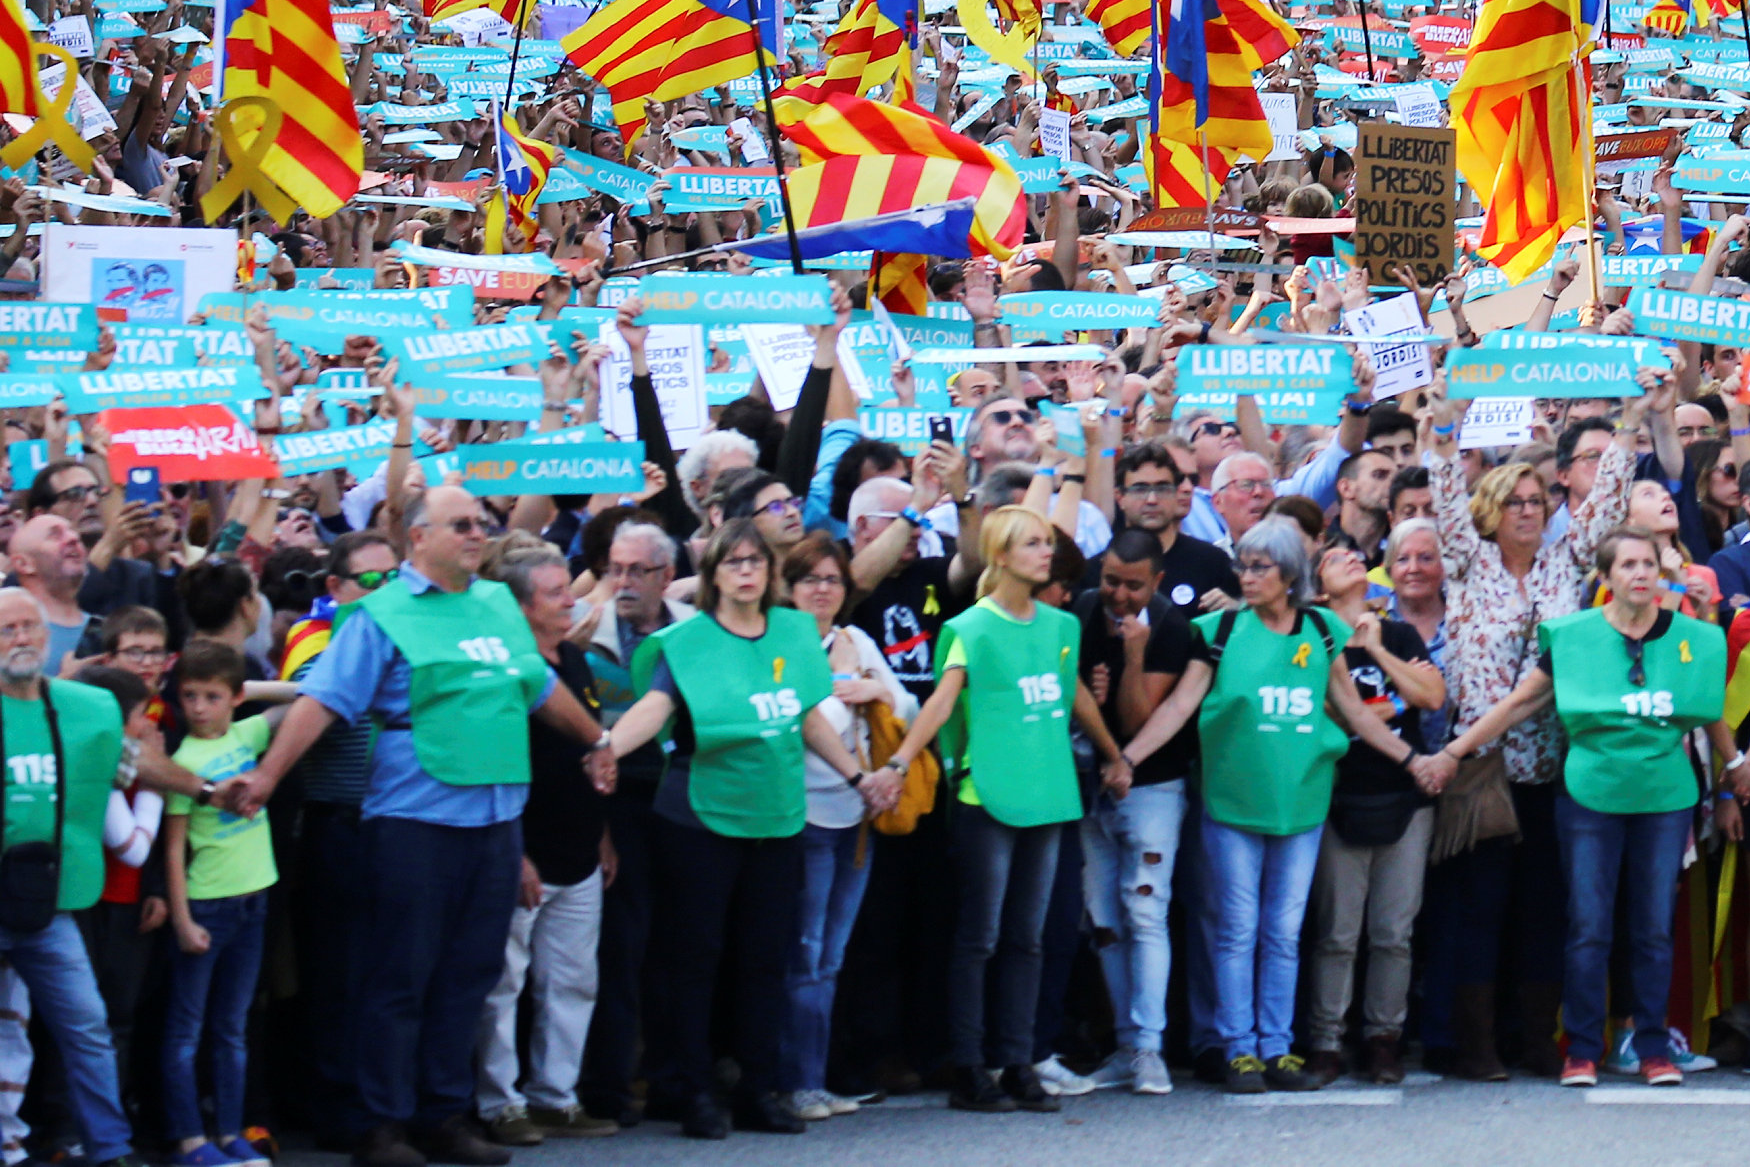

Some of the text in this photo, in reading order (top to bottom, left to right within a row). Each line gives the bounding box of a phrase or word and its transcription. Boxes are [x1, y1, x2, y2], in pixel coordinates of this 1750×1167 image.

[1434, 60, 1466, 73] SAV
[1595, 137, 1668, 155] AVE EUROPE
[598, 169, 646, 192] CATALO
[1371, 165, 1444, 195] PRESOS
[1680, 168, 1723, 181] HELP
[680, 176, 779, 195] LLIBERTA
[438, 268, 499, 288] SAVE
[643, 291, 825, 310] HELP CATALONIA
[998, 302, 1154, 318] HELP CATALONIA
[320, 308, 427, 327] CATALONIA
[1650, 322, 1667, 331] US
[1674, 323, 1717, 340] VOLEM
[405, 325, 531, 361] LLIBERTAT
[612, 346, 689, 362] LLERTAT
[1191, 348, 1335, 376] LLIBERTAT
[1377, 345, 1423, 369] JORDIS!
[80, 368, 236, 394] LLIBERTAT
[1451, 363, 1631, 382] HELP CATALONIA
[1464, 413, 1519, 424] ORDIS!
[467, 458, 635, 479] HELP CATALONIA
[458, 637, 509, 662] 11S
[1018, 675, 1063, 705] 11S
[750, 689, 801, 720] 11S
[1259, 687, 1314, 716] 11S
[1621, 691, 1674, 718] 11S
